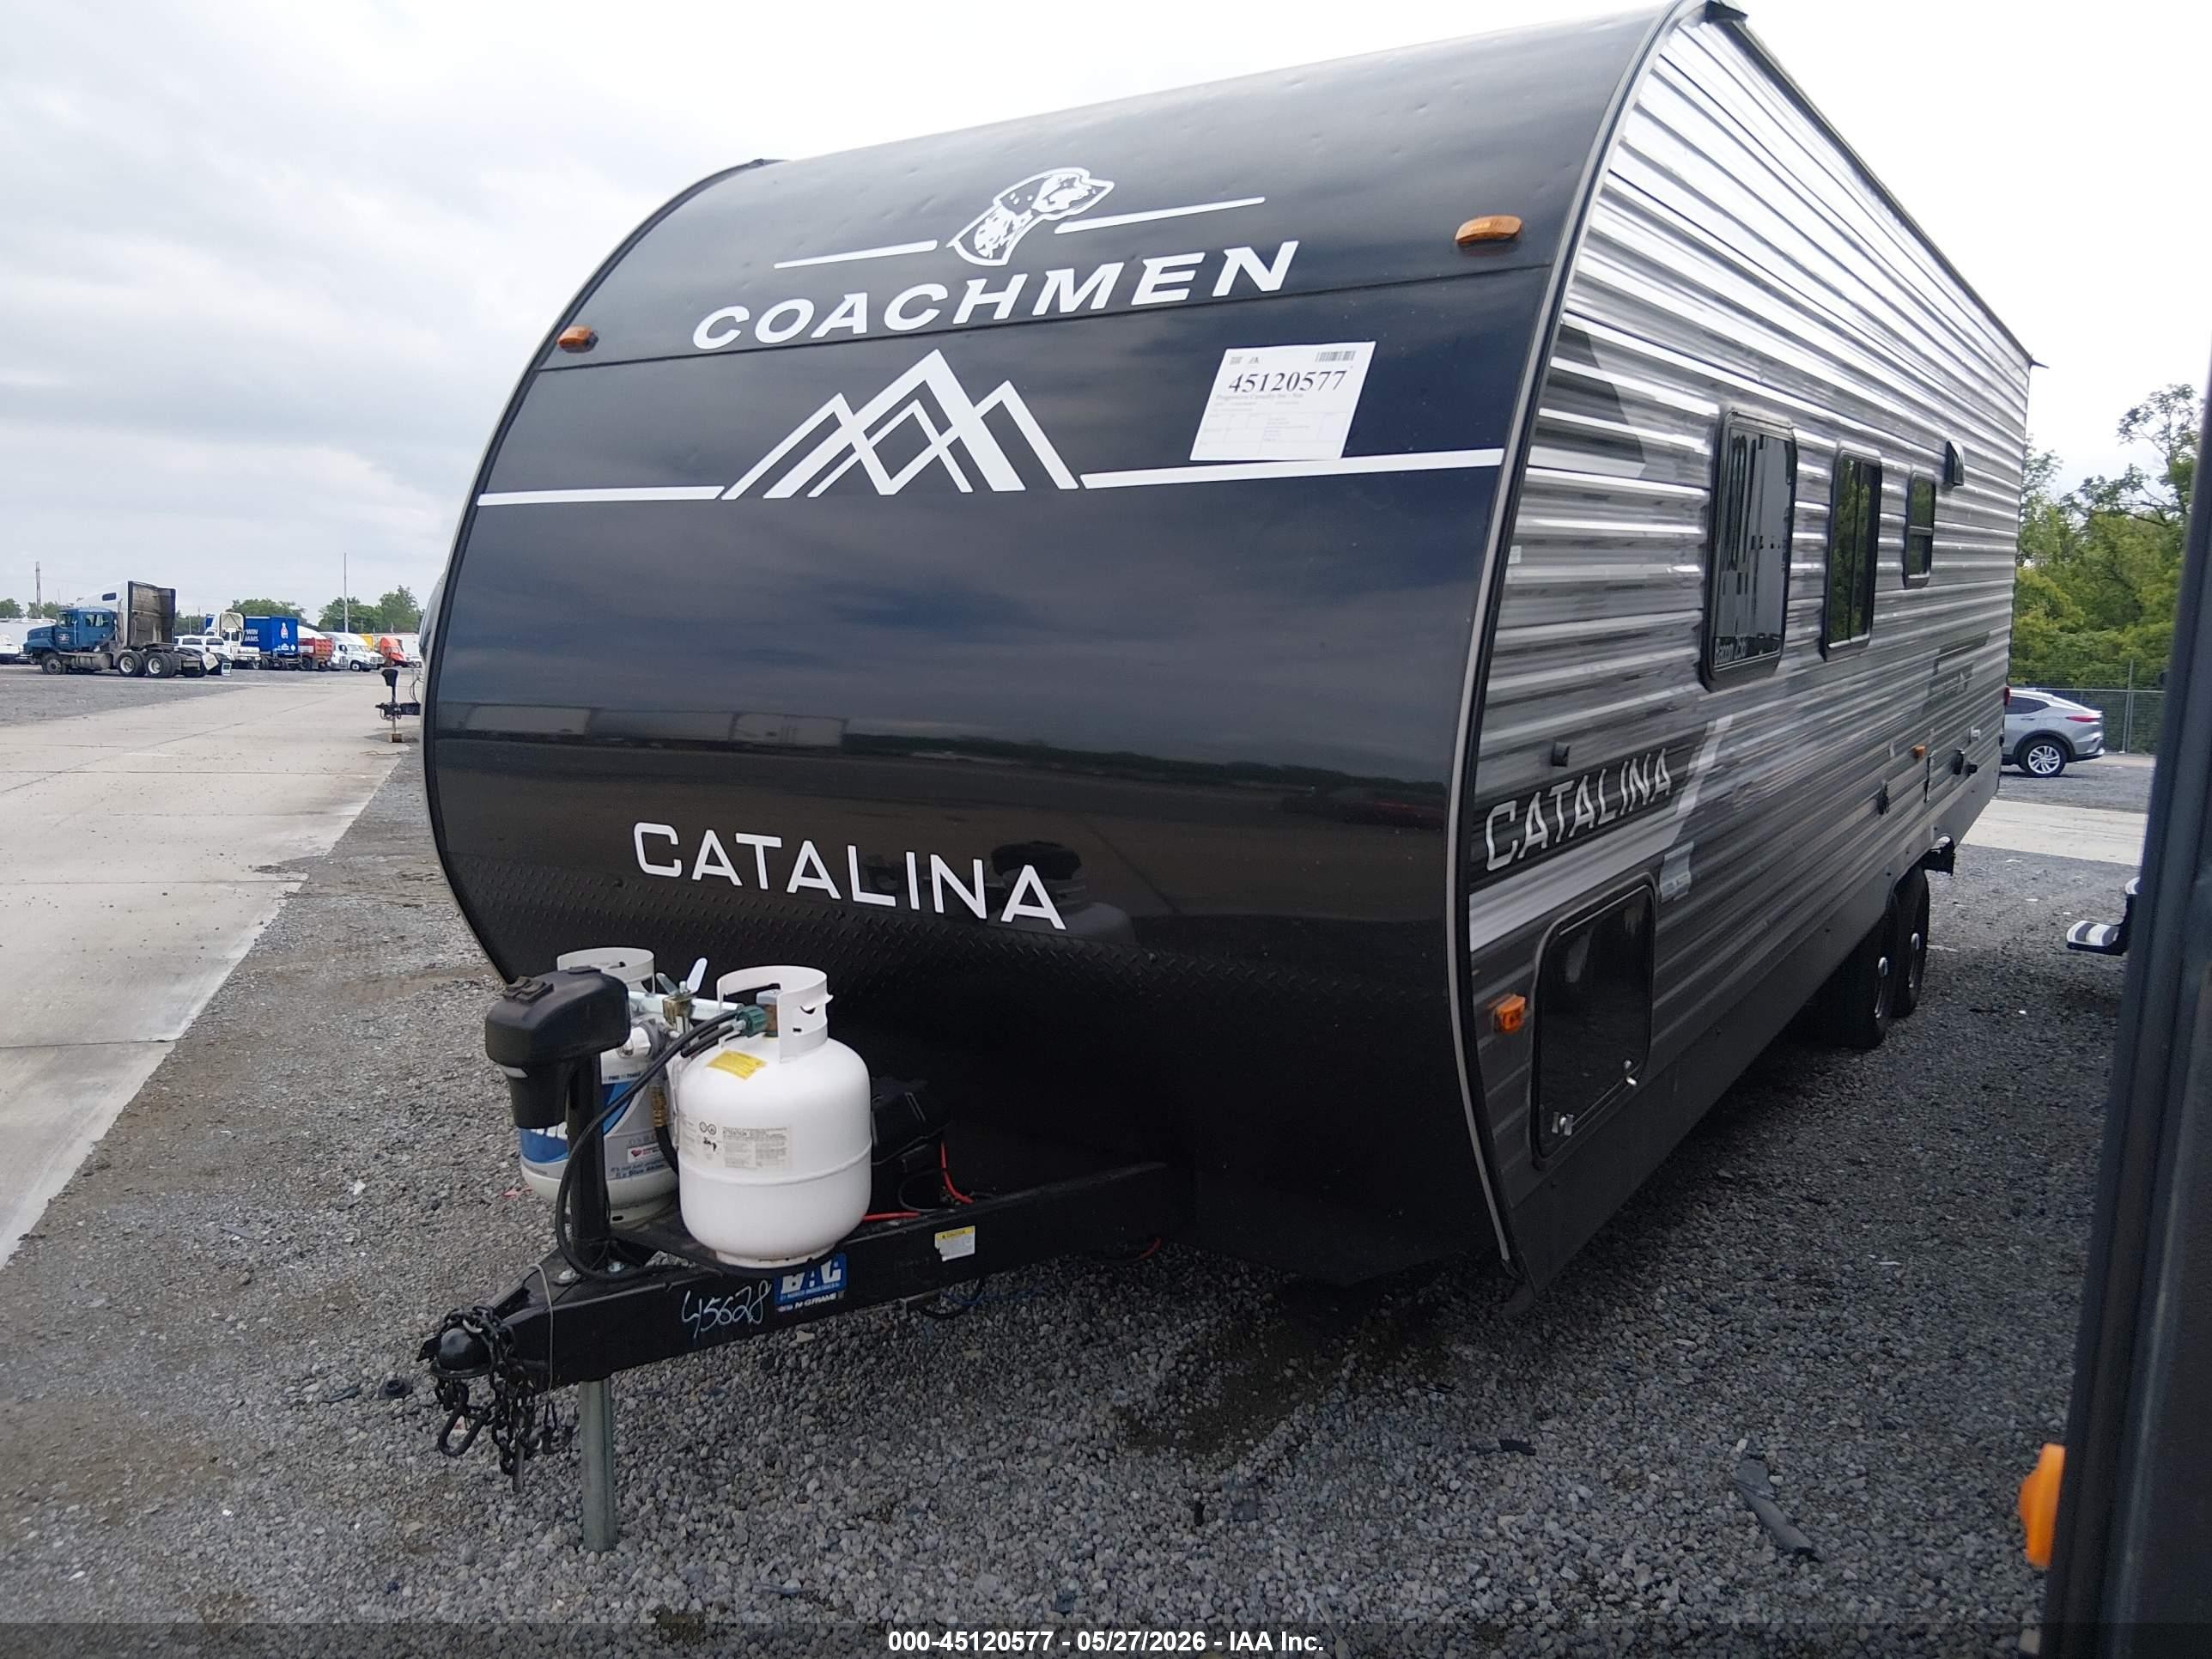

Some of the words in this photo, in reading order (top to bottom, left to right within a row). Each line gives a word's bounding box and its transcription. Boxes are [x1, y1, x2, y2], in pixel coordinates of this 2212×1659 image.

[693, 241, 1298, 349] COACHMEN
[1228, 370, 1347, 393] 45120577
[1486, 748, 1672, 872] CATALINA
[634, 823, 1066, 930] CATALINA
[682, 1279, 772, 1339] 45628
